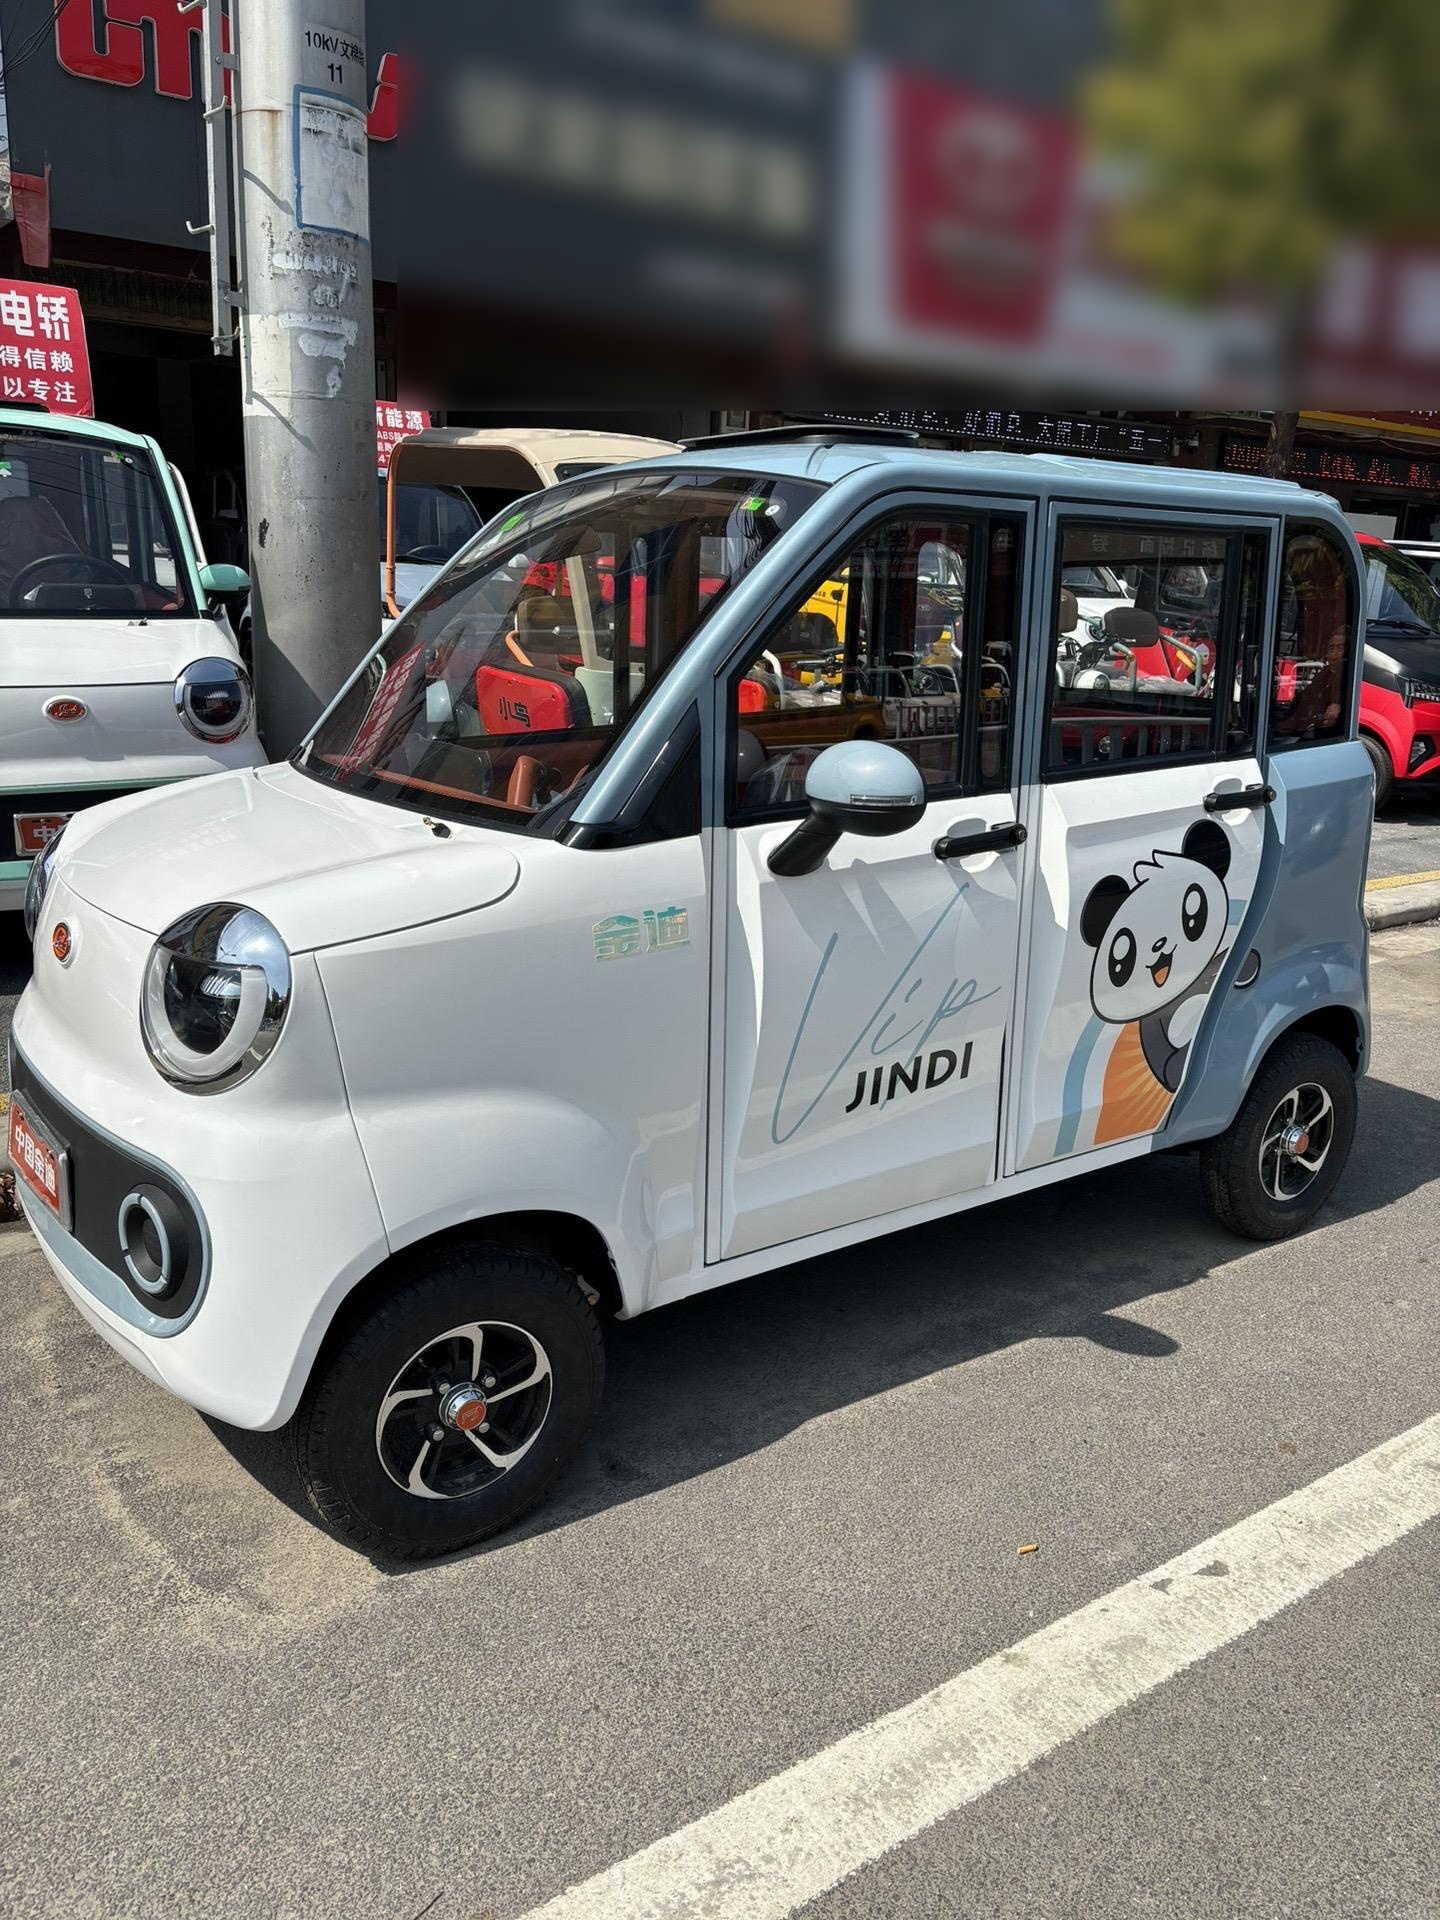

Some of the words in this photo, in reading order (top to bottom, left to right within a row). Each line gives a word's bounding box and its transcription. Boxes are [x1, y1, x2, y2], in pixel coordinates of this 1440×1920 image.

[327, 63, 343, 84] 11
[0, 290, 70, 341] 电轿
[0, 345, 74, 373] 得信赖
[3, 376, 77, 403] 以专注
[591, 905, 688, 961] 金迪
[771, 881, 1001, 1144] Vip
[845, 1040, 974, 1114] JINDI
[15, 1124, 57, 1198] 中国金迪
